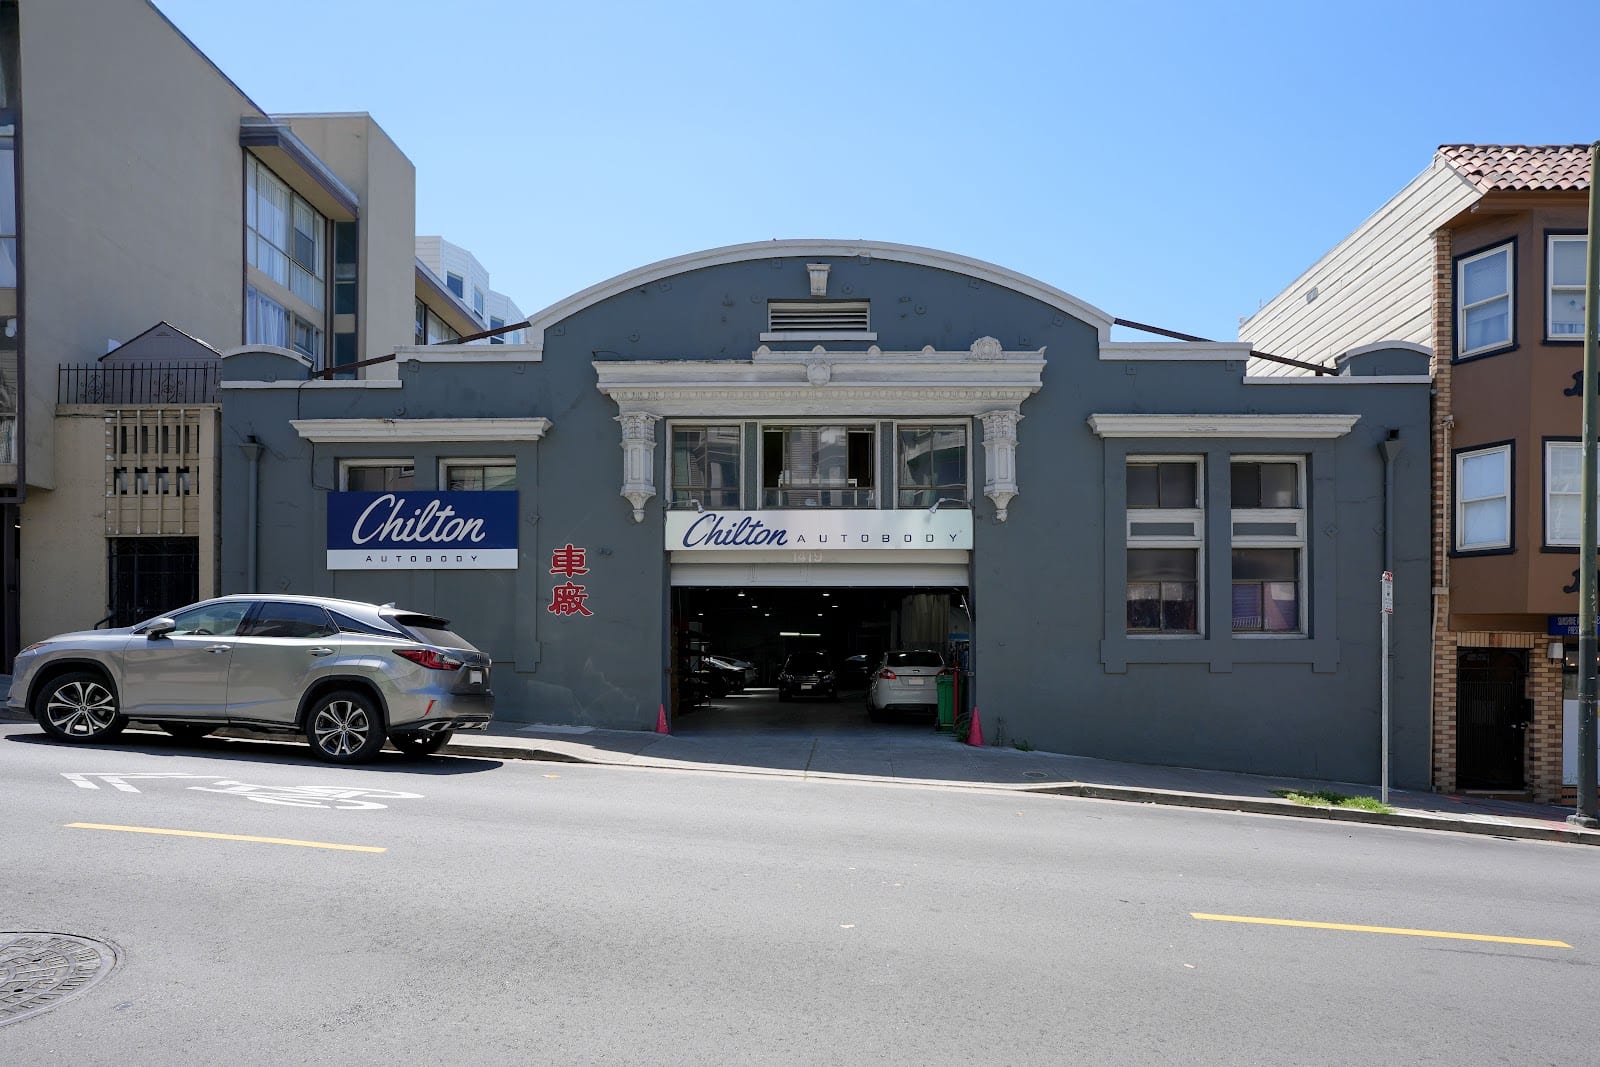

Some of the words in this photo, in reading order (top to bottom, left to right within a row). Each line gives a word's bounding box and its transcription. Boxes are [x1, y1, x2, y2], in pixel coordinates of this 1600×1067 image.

[352, 493, 486, 545] Chilton
[683, 512, 788, 548] Chilton
[797, 533, 957, 543] AUTOBODY
[365, 555, 478, 563] AUTOBODY
[549, 544, 593, 616] 車廠
